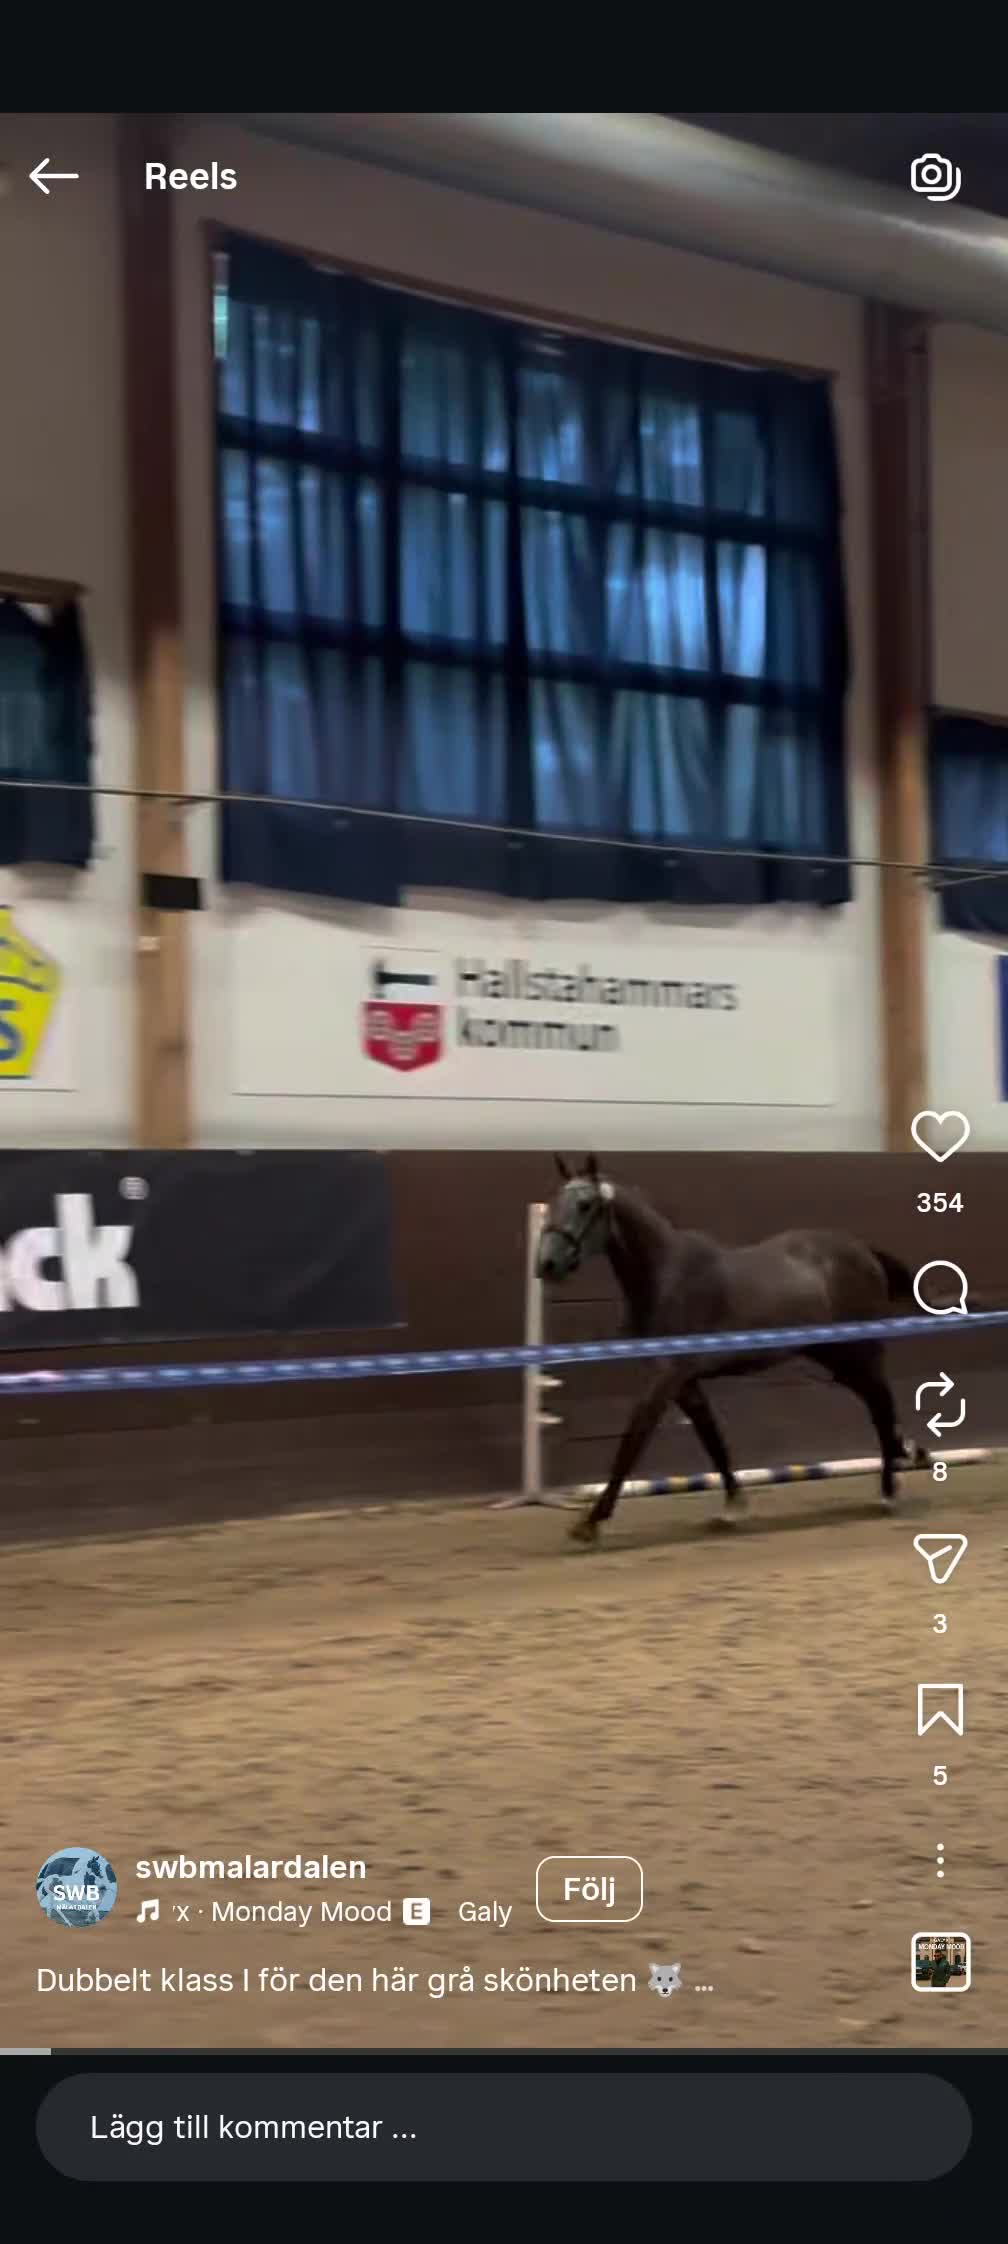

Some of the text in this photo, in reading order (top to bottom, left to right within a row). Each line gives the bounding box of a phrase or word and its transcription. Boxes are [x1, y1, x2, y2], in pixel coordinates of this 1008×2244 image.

[453, 957, 738, 1011] Hallstahammars
[455, 1004, 620, 1052] kommun
[0, 1193, 140, 1312] ck
